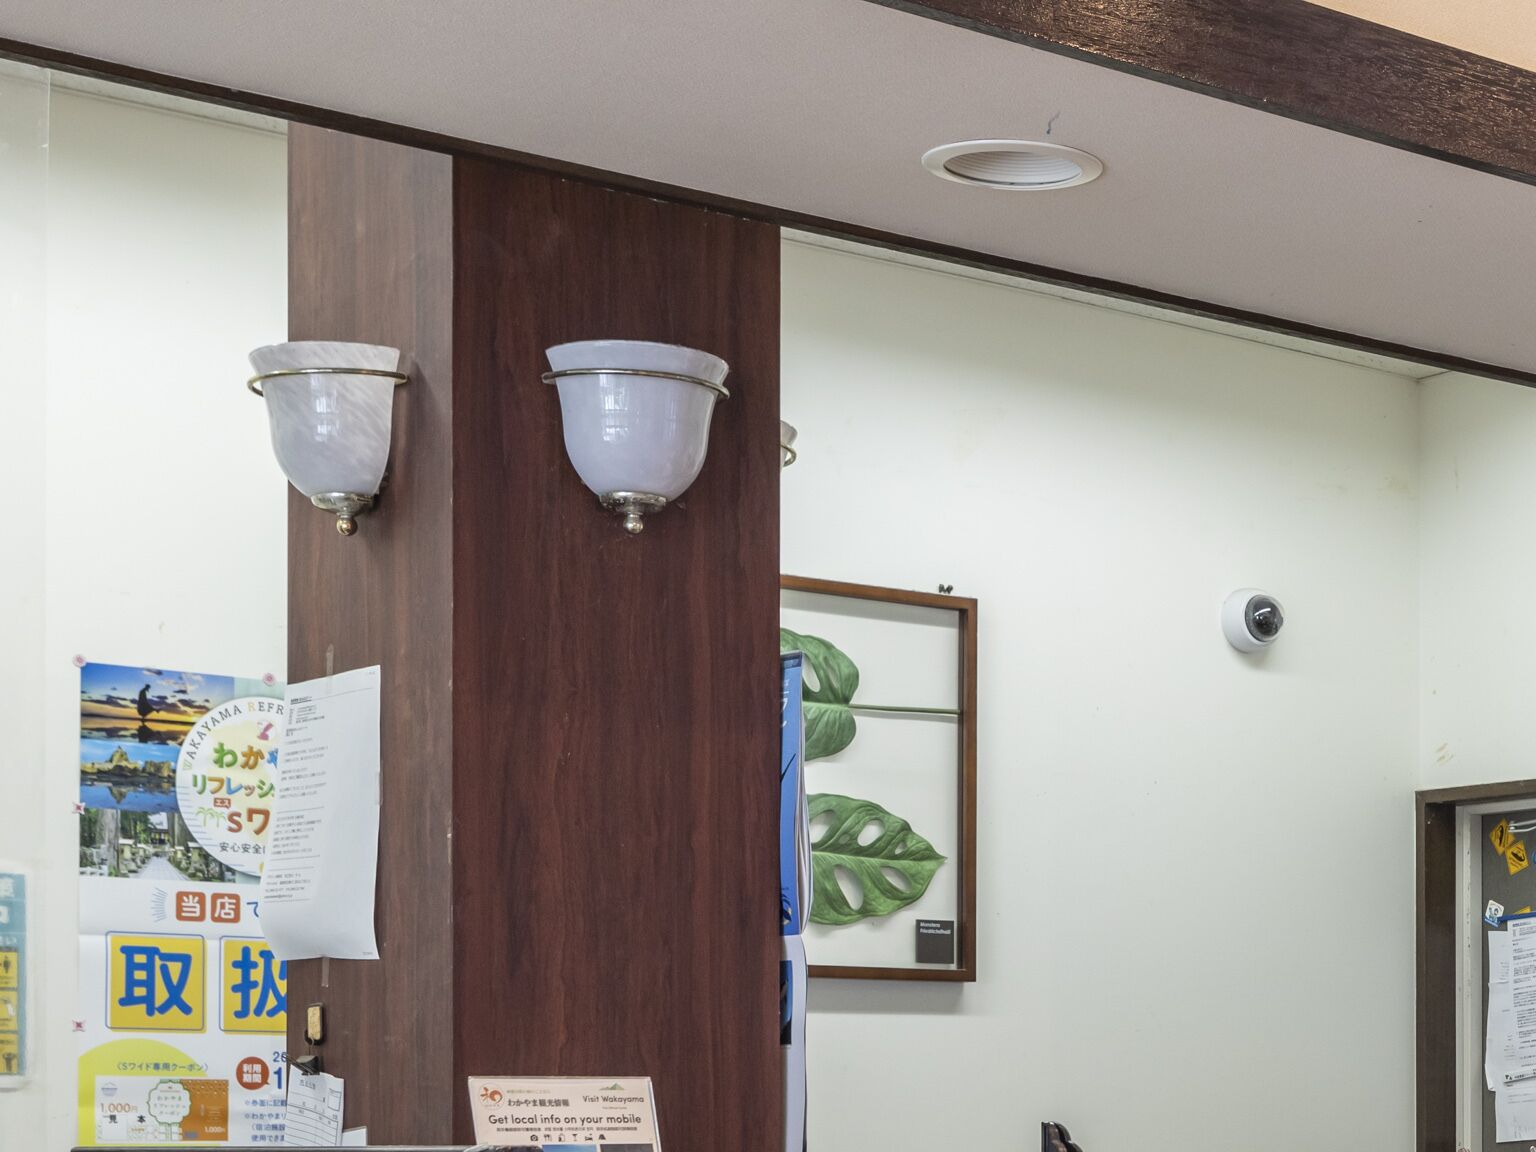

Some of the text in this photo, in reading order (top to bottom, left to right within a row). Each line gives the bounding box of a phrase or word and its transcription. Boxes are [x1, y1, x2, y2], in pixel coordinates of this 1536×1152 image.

[182, 704, 242, 770] WAKAYAMA
[601, 1096, 644, 1105] Wakayama
[488, 1114, 642, 1126] Get local info on your mobile
